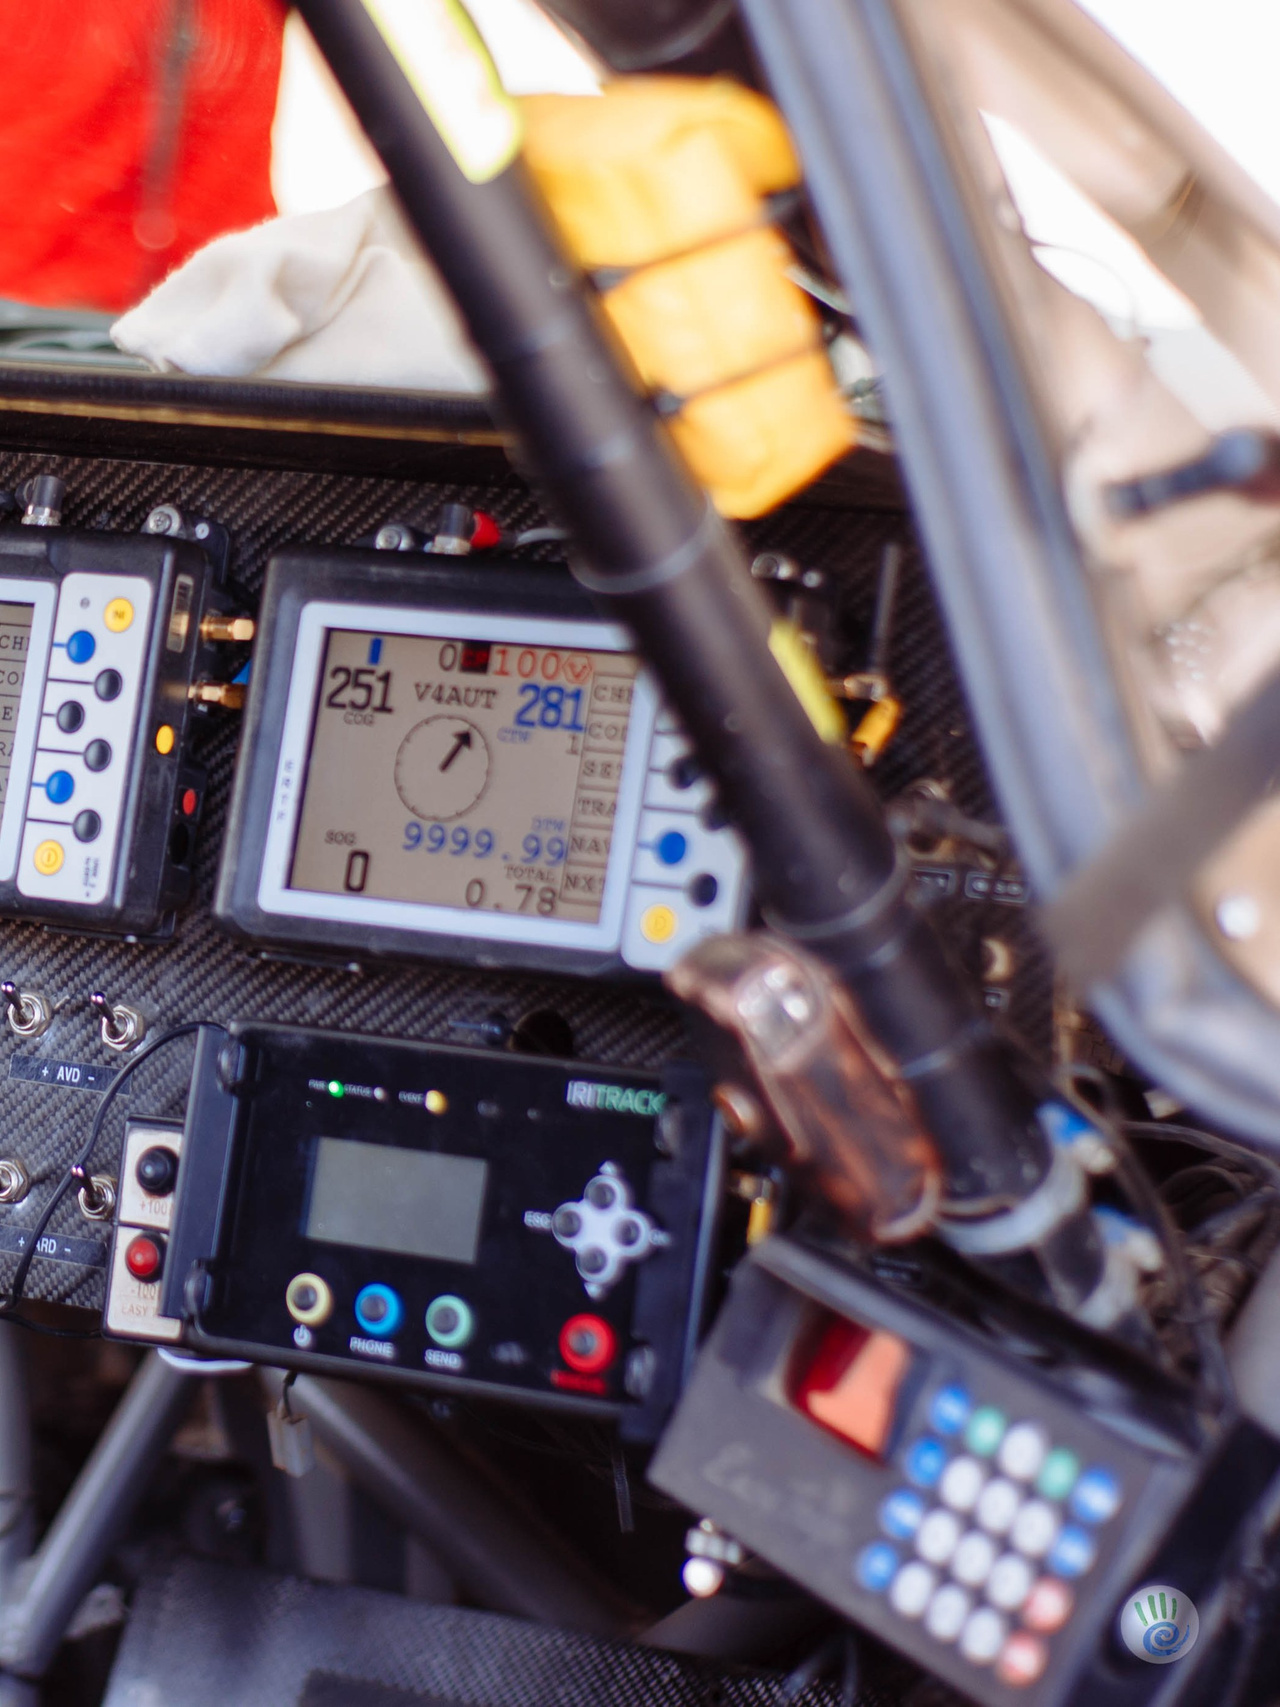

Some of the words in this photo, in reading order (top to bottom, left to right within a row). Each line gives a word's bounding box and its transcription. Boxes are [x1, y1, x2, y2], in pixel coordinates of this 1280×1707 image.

[439, 643, 457, 672] 0
[493, 648, 562, 681] 100
[325, 666, 394, 713] 251
[414, 682, 497, 709] V4AUT
[514, 683, 585, 733] 281
[402, 821, 566, 867] 9999.99
[344, 850, 370, 892] 0
[504, 865, 555, 882] TOTAL
[465, 877, 558, 916] 0.78
[57, 1065, 80, 1083] AVD
[349, 1336, 394, 1358] PHONE
[425, 1349, 463, 1370] SEND
